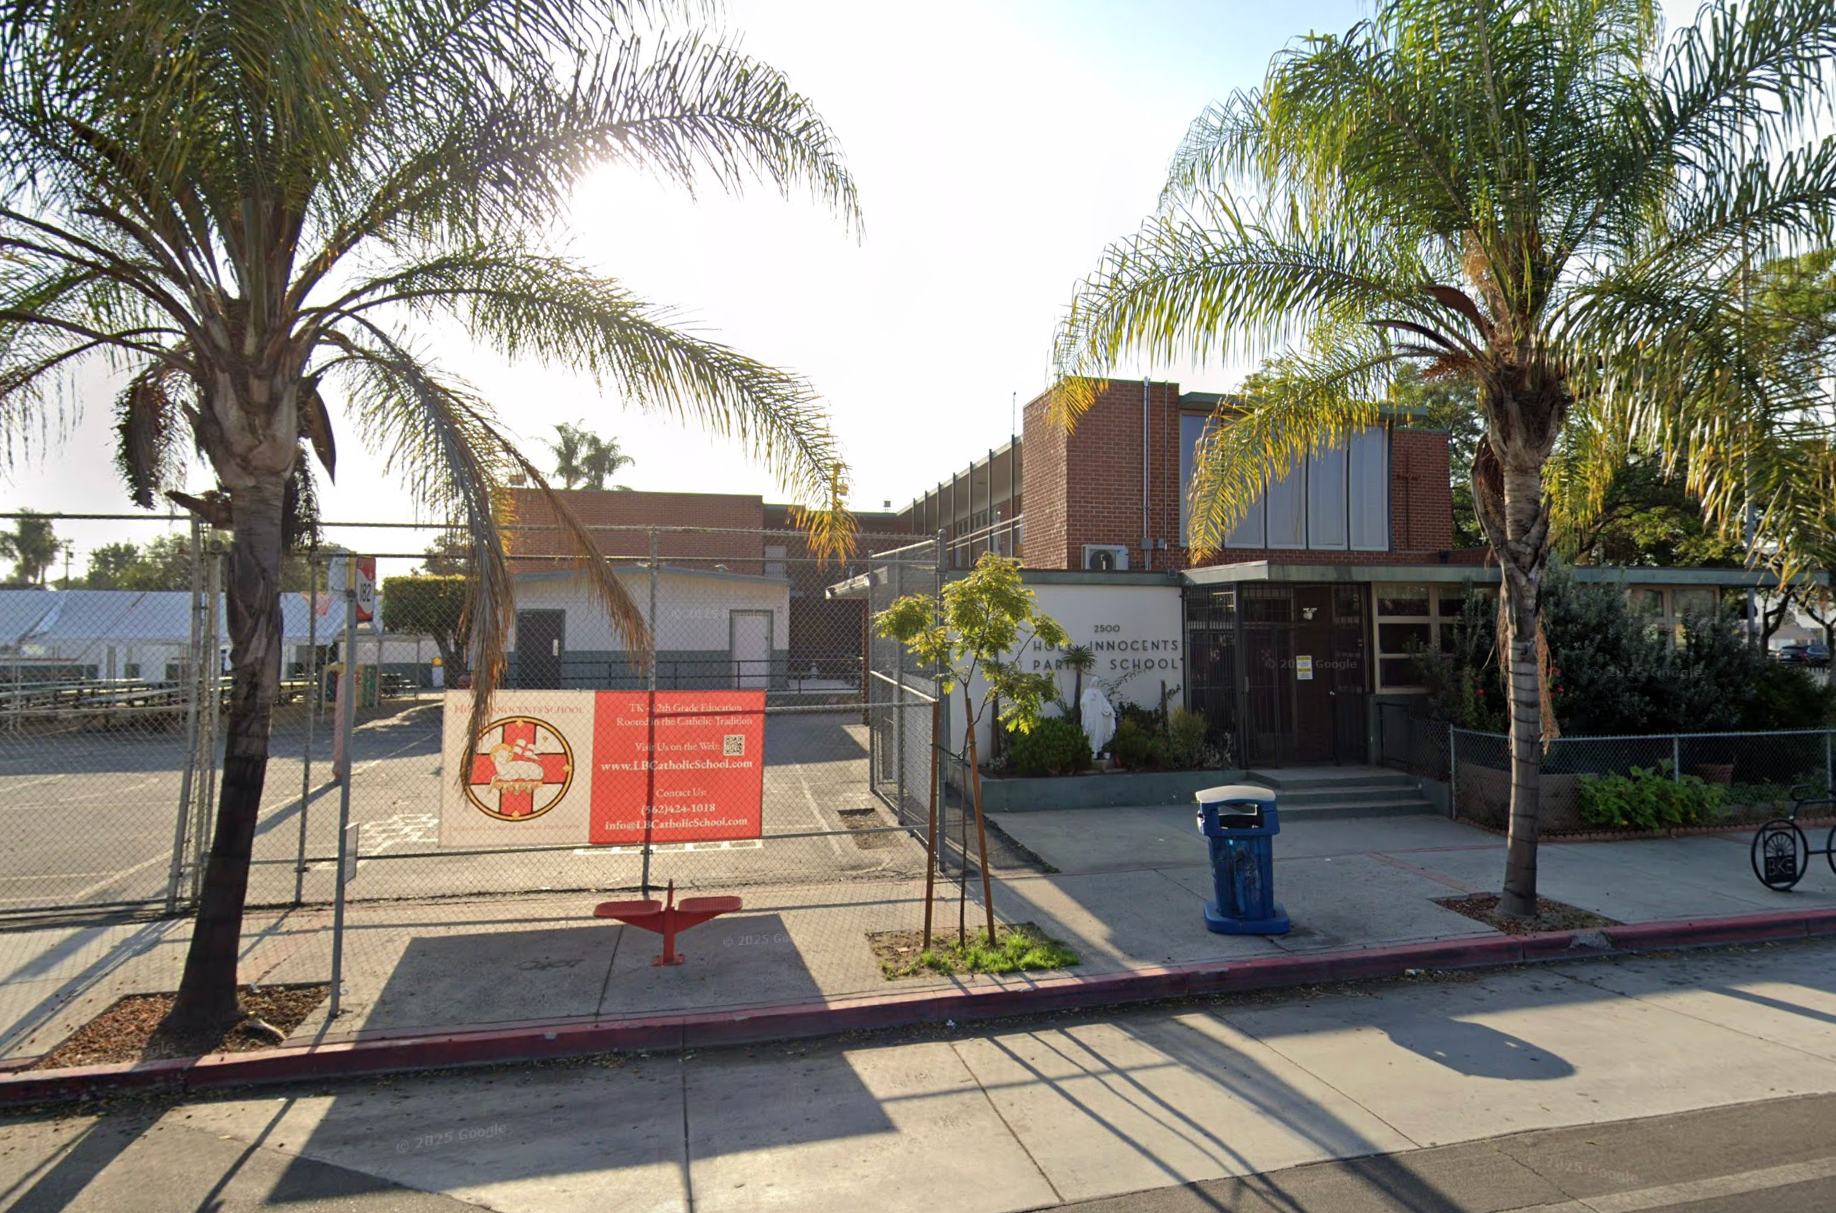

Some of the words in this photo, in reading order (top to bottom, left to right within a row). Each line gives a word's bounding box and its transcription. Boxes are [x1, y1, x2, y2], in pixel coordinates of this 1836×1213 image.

[1094, 624, 1121, 633] 2500
[1089, 640, 1178, 651] INNOCENTS
[1110, 658, 1178, 670] SCHOOL
[629, 703, 645, 712] TK
[673, 702, 699, 713] Grade
[701, 703, 742, 712] Education
[617, 717, 650, 727] Rooted
[651, 718, 661, 726] in
[662, 717, 676, 726] the
[678, 716, 712, 726] Catholic
[715, 716, 753, 726] Tradition
[635, 743, 655, 752] Visit
[657, 743, 669, 752] Us
[683, 742, 698, 752] the
[699, 742, 721, 751] Web:
[600, 758, 753, 772] www.LBCatholicSchool.com
[656, 787, 691, 798] Contact
[692, 787, 707, 797] Us:
[641, 803, 716, 817] (562)424-1018
[605, 817, 748, 831] info@LBCatholicSchool.com
